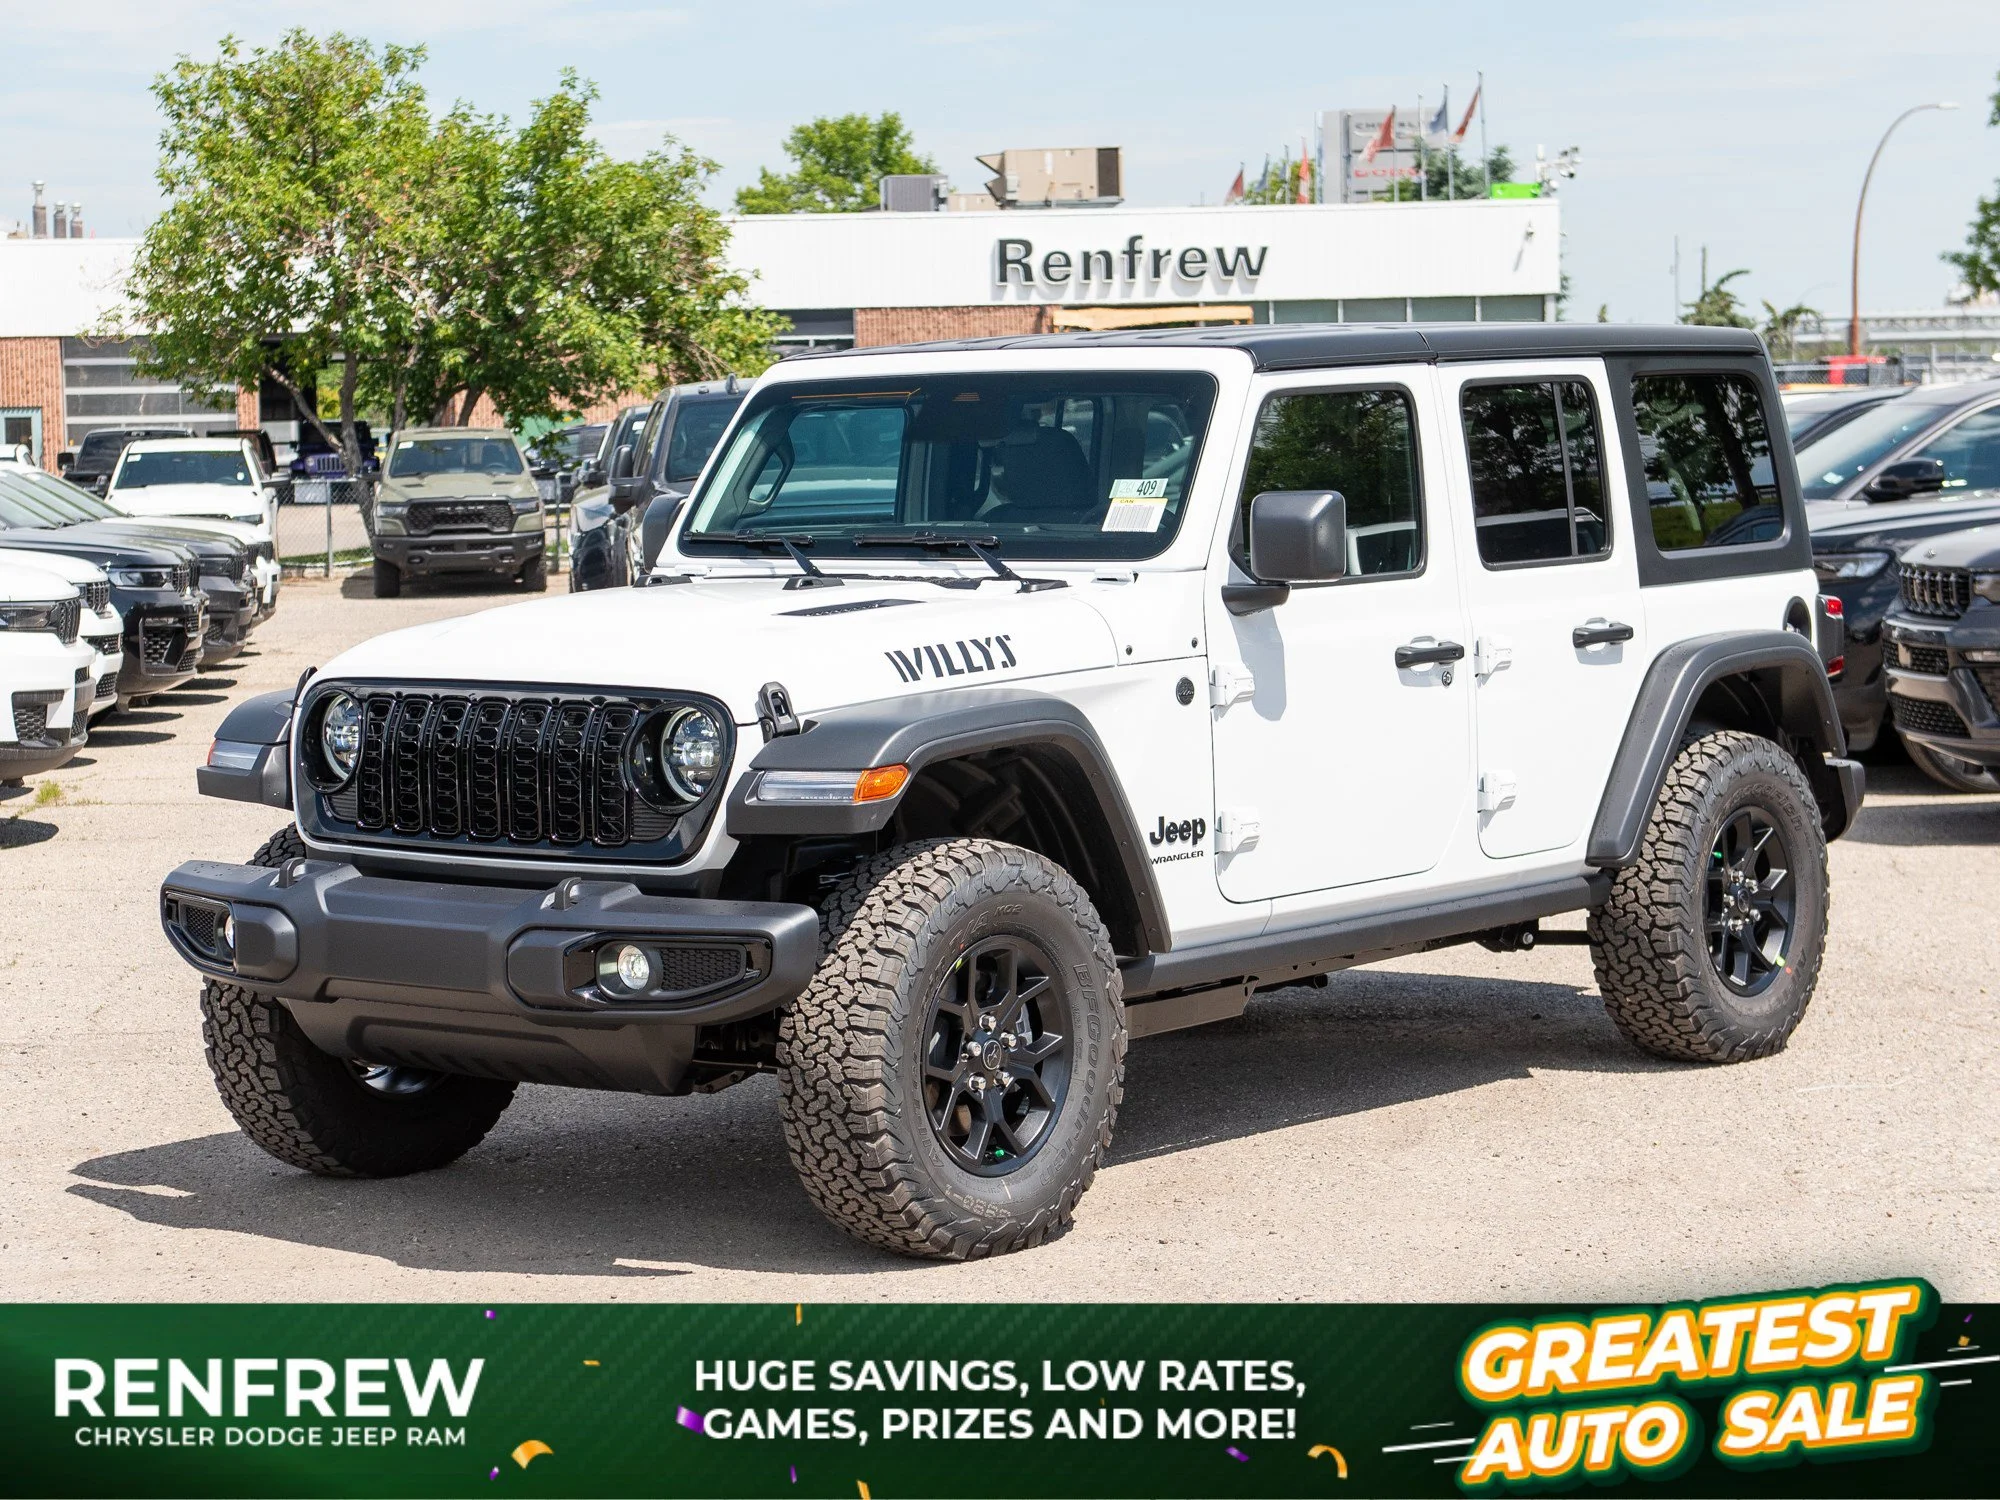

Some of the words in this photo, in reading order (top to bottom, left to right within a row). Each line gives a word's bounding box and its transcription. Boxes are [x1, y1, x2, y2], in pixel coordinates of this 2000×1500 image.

[998, 235, 1269, 284] Renfrew
[1136, 480, 1158, 496] 409
[884, 634, 1017, 683] WILLYS
[1149, 815, 1207, 846] Jeep
[1150, 850, 1204, 866] WRANGLER
[1039, 963, 1102, 1187] BFGoodrich
